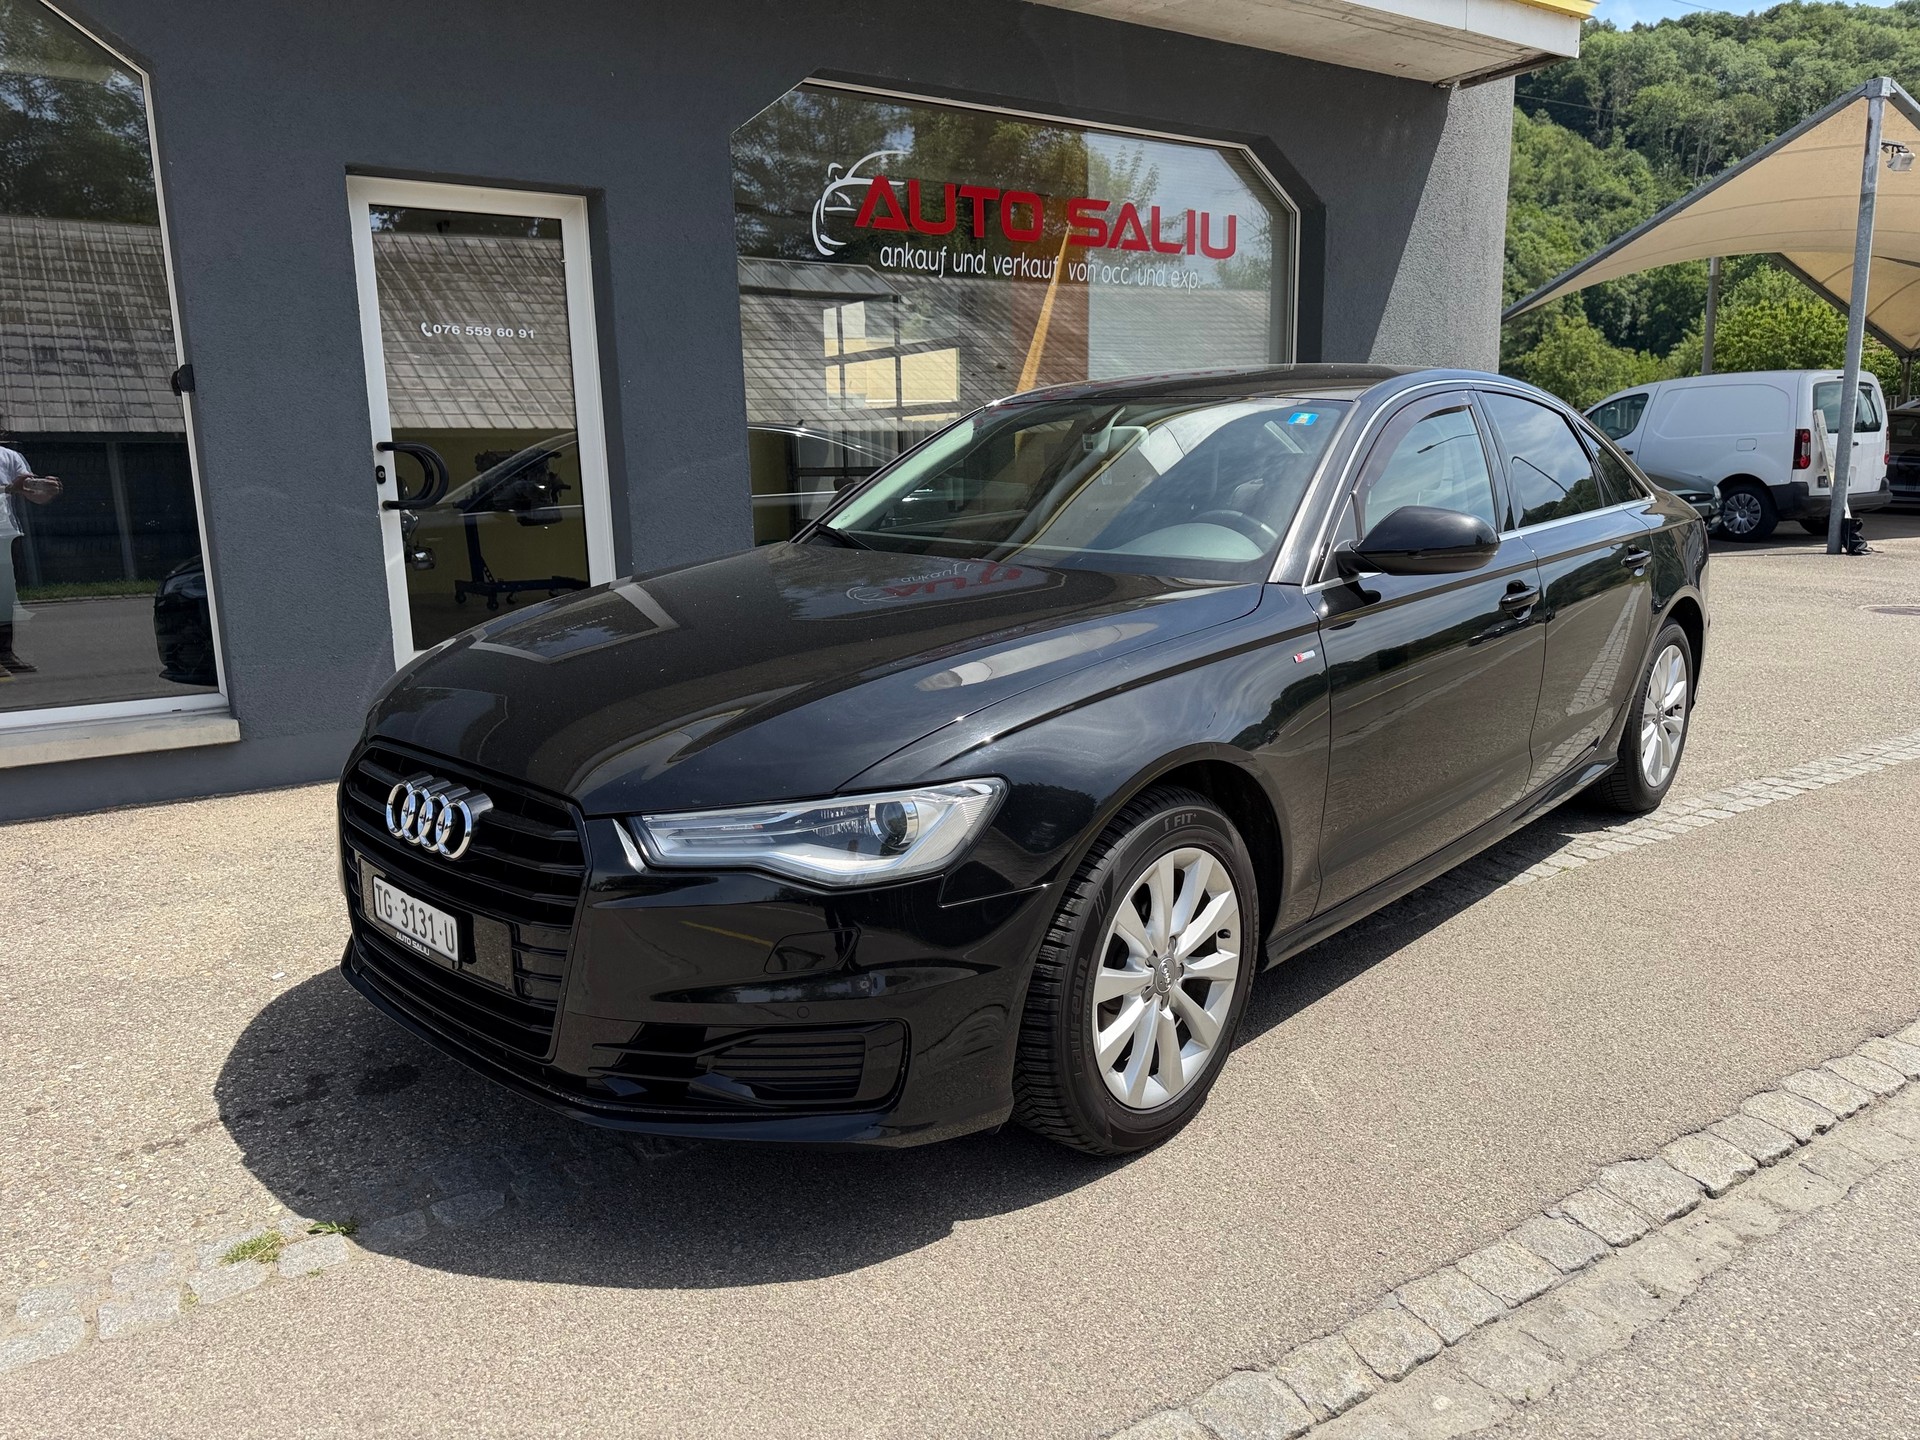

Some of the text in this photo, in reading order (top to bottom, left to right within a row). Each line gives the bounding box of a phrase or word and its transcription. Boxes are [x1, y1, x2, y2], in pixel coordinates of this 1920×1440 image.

[854, 175, 1237, 260] AUTO SALIU
[880, 242, 1201, 295] ankauf und verkauf von occ. und exp.
[433, 324, 535, 339] 076 559 60 91
